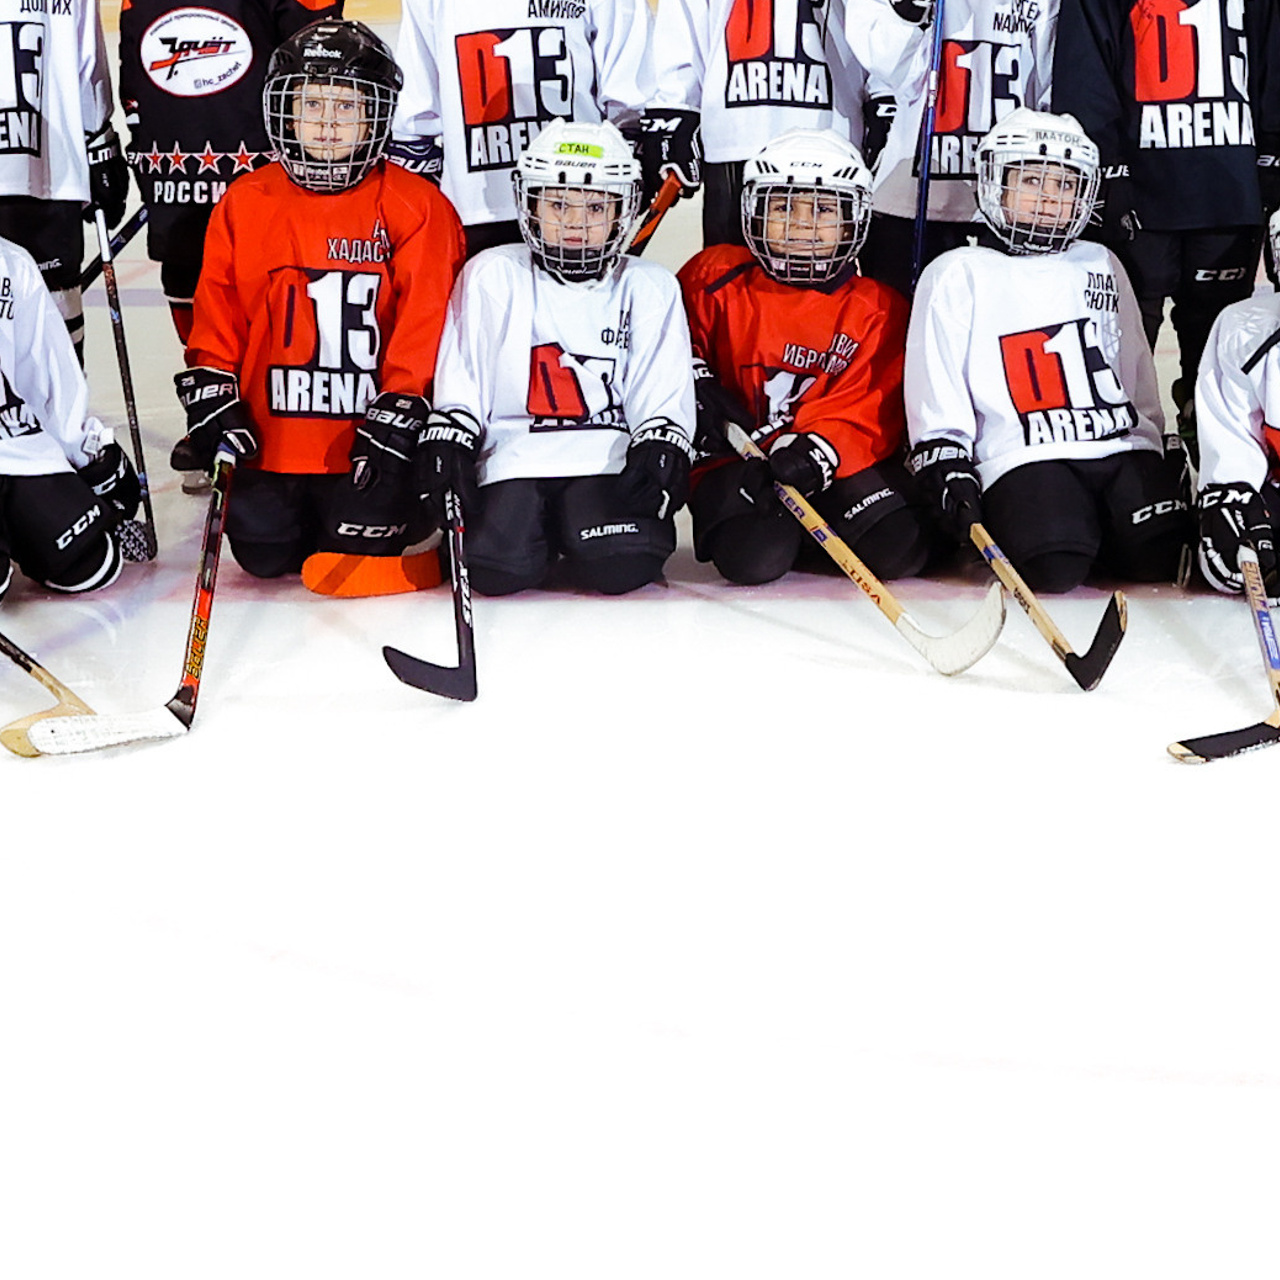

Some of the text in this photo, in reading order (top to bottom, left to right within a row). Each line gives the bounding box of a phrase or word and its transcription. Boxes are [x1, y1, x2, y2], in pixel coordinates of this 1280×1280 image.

[0, 23, 44, 112] 13
[303, 44, 343, 59] Reebok
[456, 28, 575, 124] D13
[727, 60, 830, 104] ARENA
[470, 120, 550, 167] ARE
[1139, 100, 1256, 149] ARENA
[554, 159, 598, 168] BAUER
[153, 180, 227, 204] РОССИ
[327, 237, 385, 264] ХАДАС
[268, 267, 381, 371] D13
[1000, 320, 1126, 413] D13
[270, 367, 378, 415] ARENA
[365, 407, 423, 433] BAUE
[1029, 407, 1134, 446] ARENA
[1131, 498, 1187, 524] CCM
[1197, 488, 1253, 509] CM
[55, 504, 102, 551] CCM
[337, 521, 407, 539] CCM
